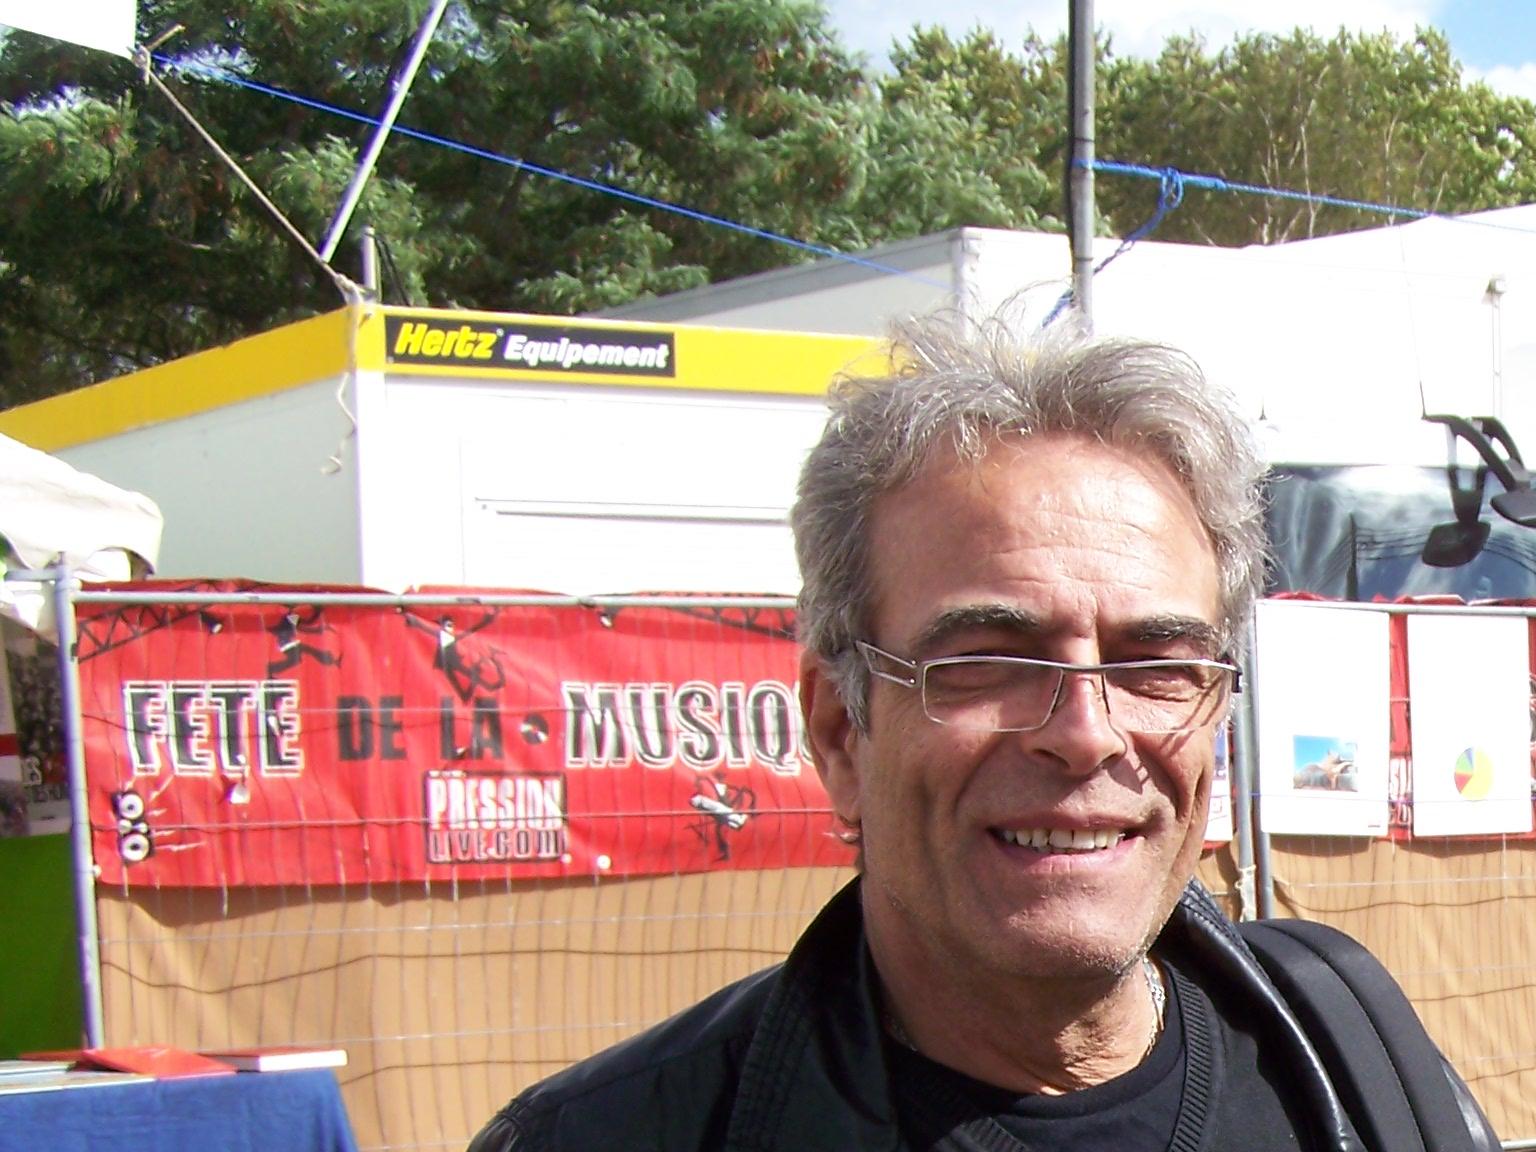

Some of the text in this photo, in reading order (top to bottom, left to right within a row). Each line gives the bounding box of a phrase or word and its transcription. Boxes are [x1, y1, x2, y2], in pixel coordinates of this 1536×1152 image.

[394, 322, 670, 369] Hertz Equipement
[123, 679, 814, 778] FETE DE LA MUSIQ
[428, 777, 563, 830] PRESSION
